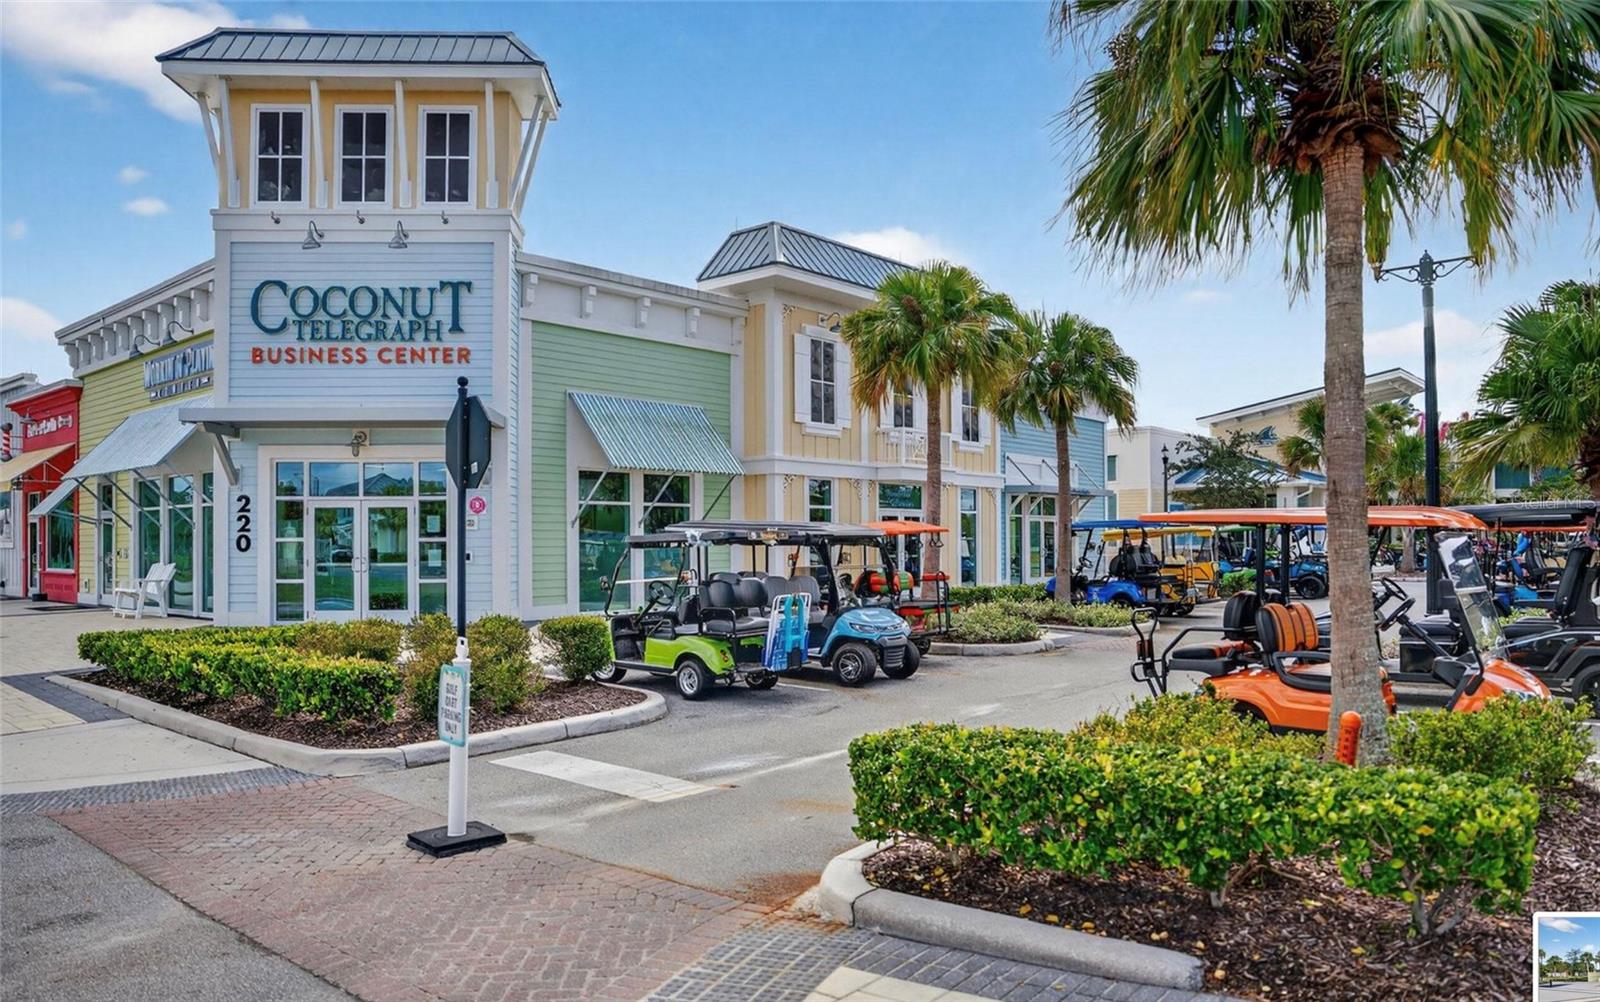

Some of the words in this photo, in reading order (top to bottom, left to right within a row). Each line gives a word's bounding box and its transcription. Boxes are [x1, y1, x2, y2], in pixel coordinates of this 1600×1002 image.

[250, 279, 472, 335] COCONUT
[293, 319, 443, 342] TELEGRAPH
[251, 346, 367, 364] BUSINESS
[377, 346, 472, 364] CENTER
[235, 494, 252, 553] 220
